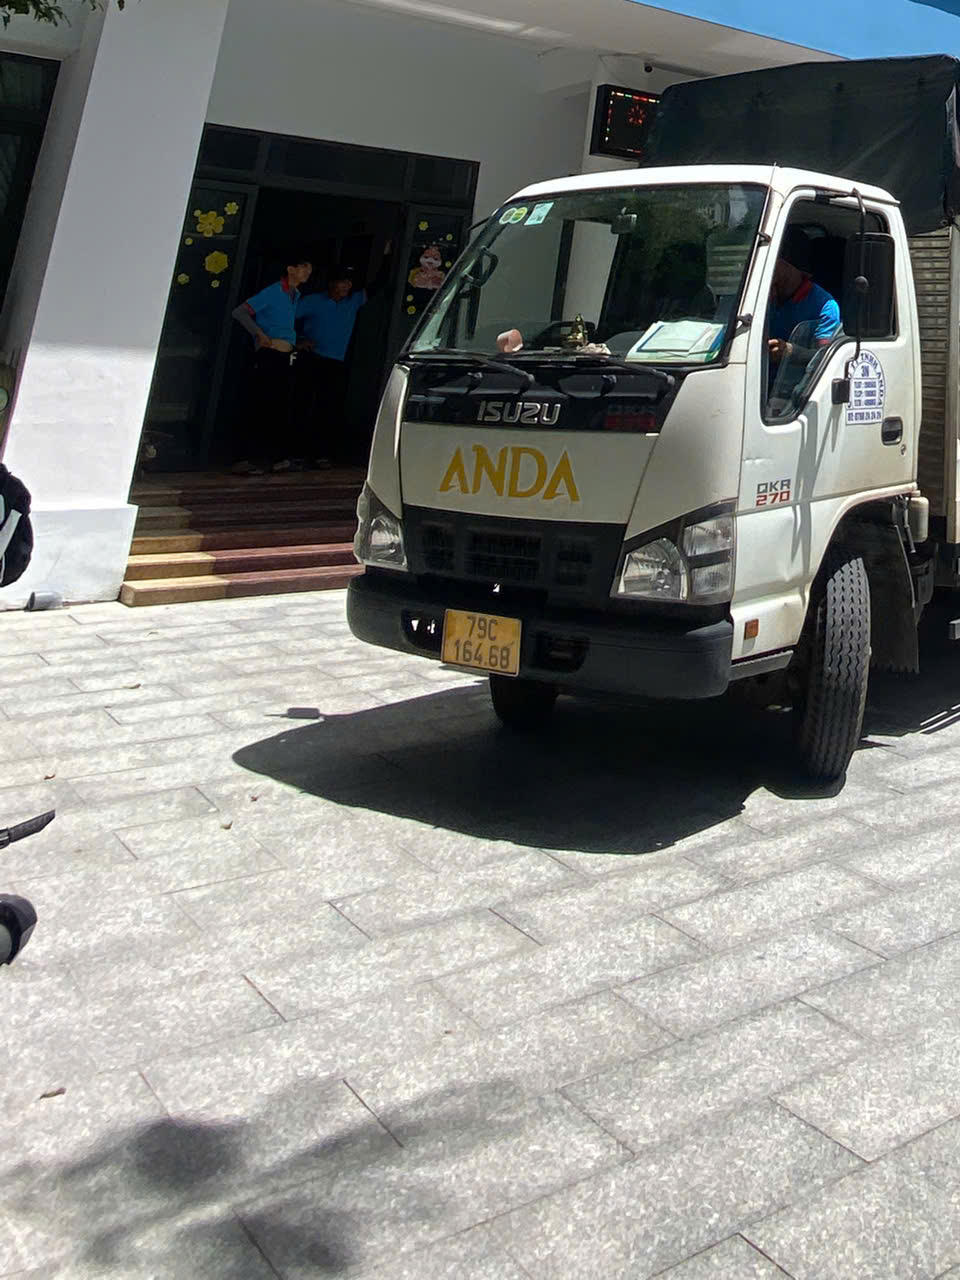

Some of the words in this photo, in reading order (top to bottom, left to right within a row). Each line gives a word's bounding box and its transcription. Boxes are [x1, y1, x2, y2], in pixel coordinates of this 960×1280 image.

[477, 401, 562, 426] ISUZU
[438, 444, 581, 502] ANDA
[756, 491, 790, 506] 270
[757, 479, 791, 494] QKR
[467, 615, 498, 641] 79C
[454, 639, 511, 669] 164.68
